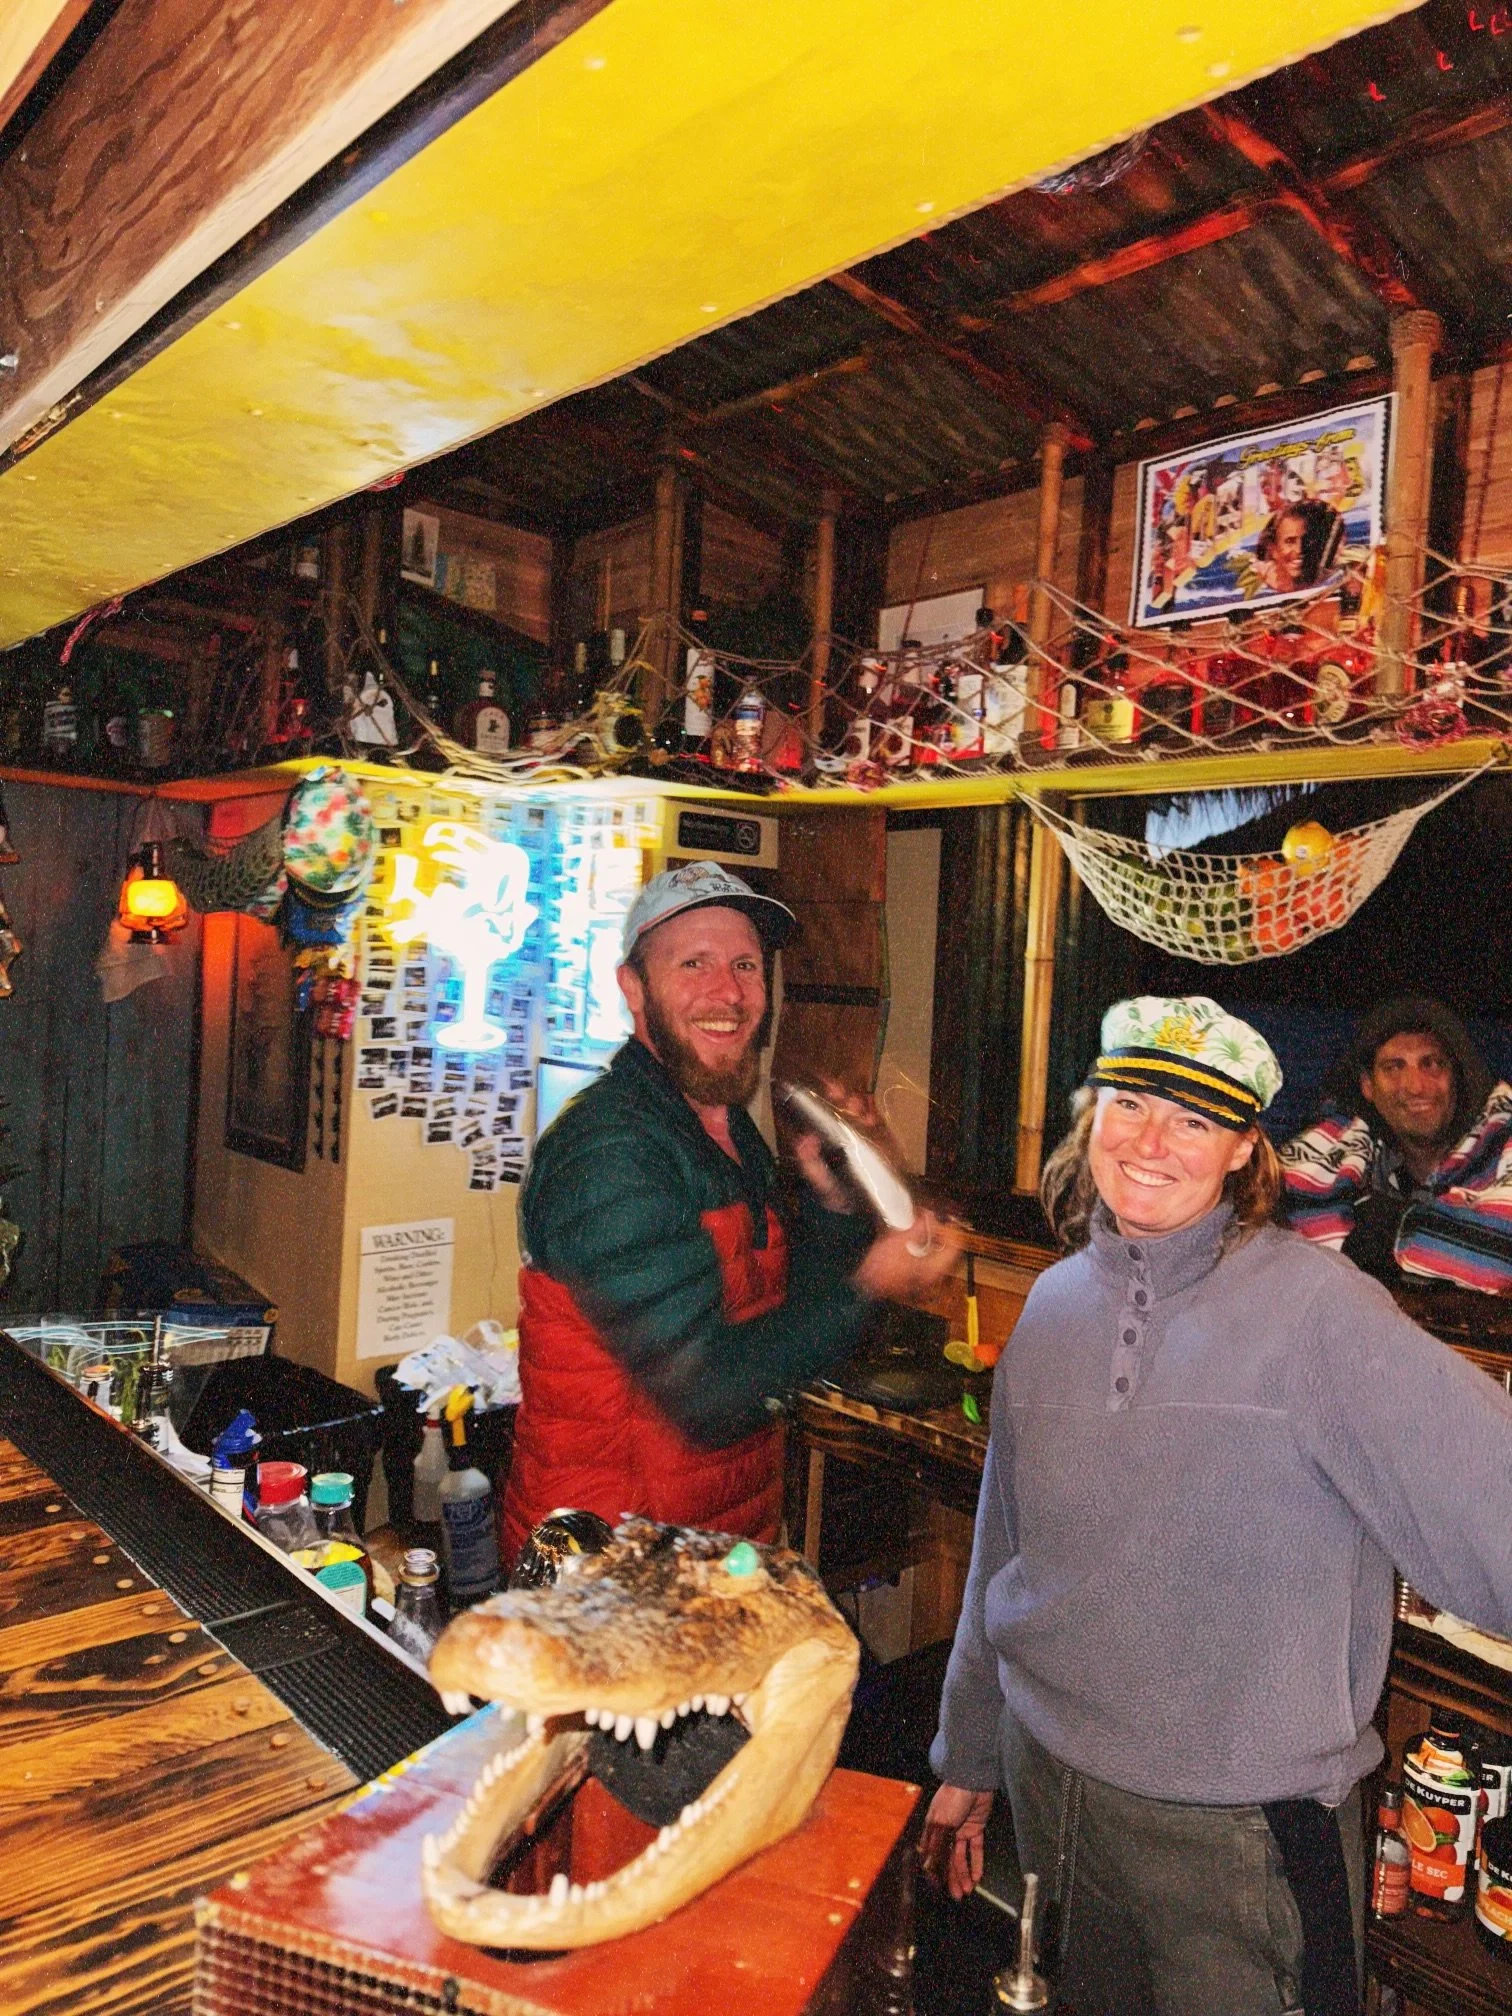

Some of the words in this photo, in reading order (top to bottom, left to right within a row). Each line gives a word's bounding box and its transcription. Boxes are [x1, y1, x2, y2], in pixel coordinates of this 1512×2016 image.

[1404, 1778, 1416, 1791] DE
[1416, 1786, 1465, 1807] KUYPER
[1426, 1866, 1448, 1879] SEC
[1488, 1862, 1500, 1875] DE
